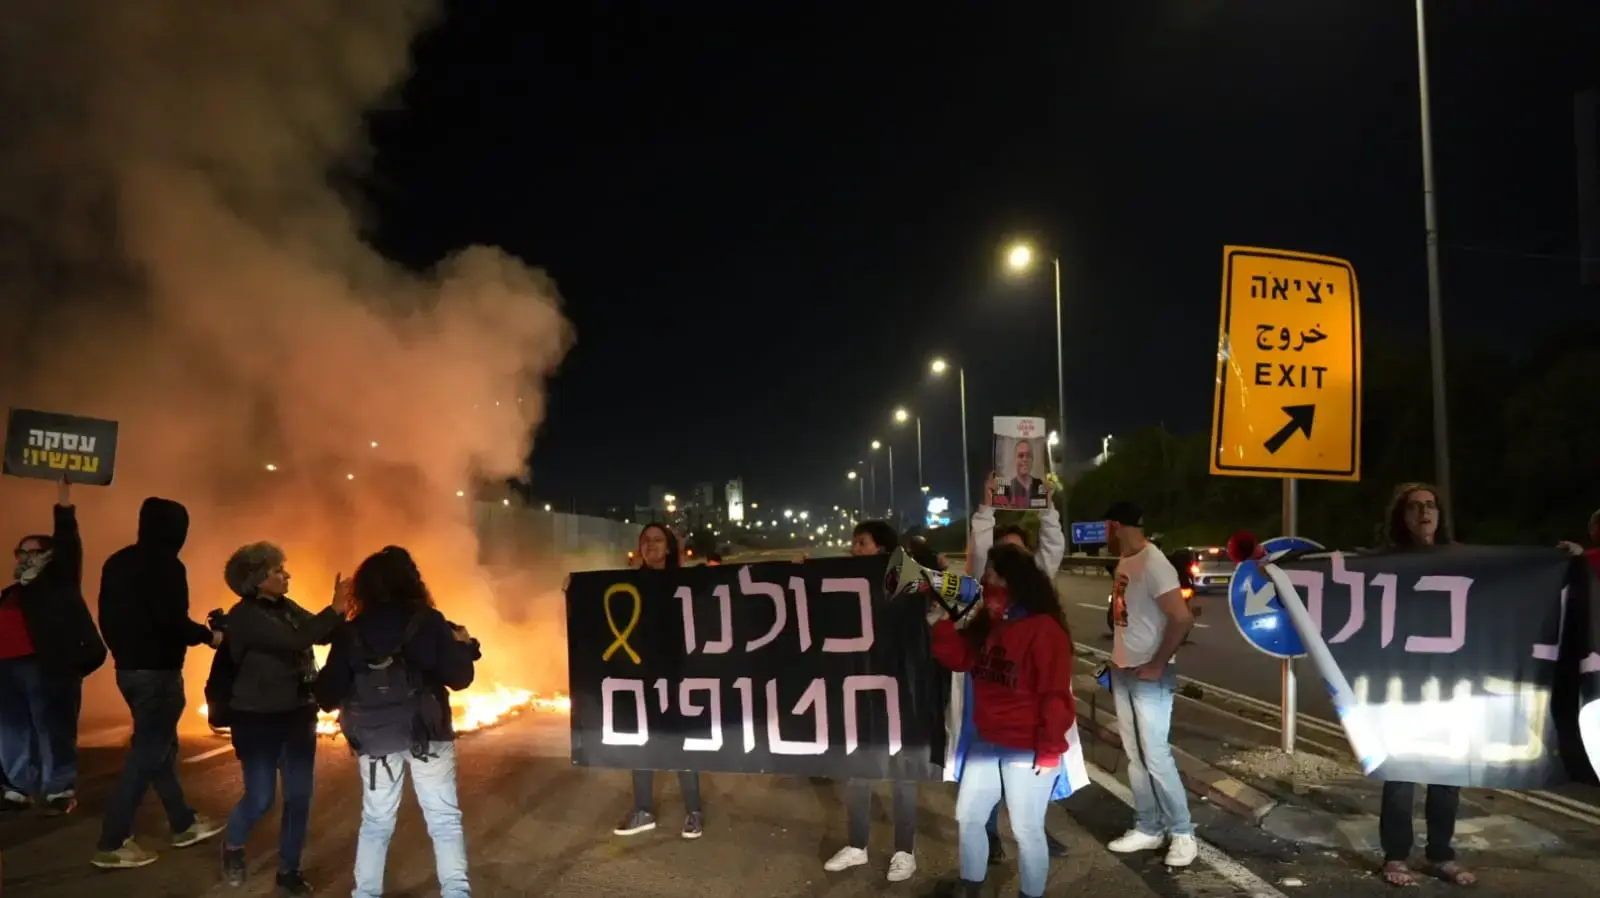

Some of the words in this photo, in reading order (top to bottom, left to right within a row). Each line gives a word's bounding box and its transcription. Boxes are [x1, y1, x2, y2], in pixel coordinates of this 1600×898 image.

[1251, 275, 1334, 304] יציאה
[1256, 323, 1328, 351] خروج
[1255, 363, 1328, 389] EXIT
[28, 429, 96, 453] עסקה
[22, 448, 99, 472] עכשיו!
[673, 565, 875, 654] כולנו
[601, 675, 902, 756] חטופים
